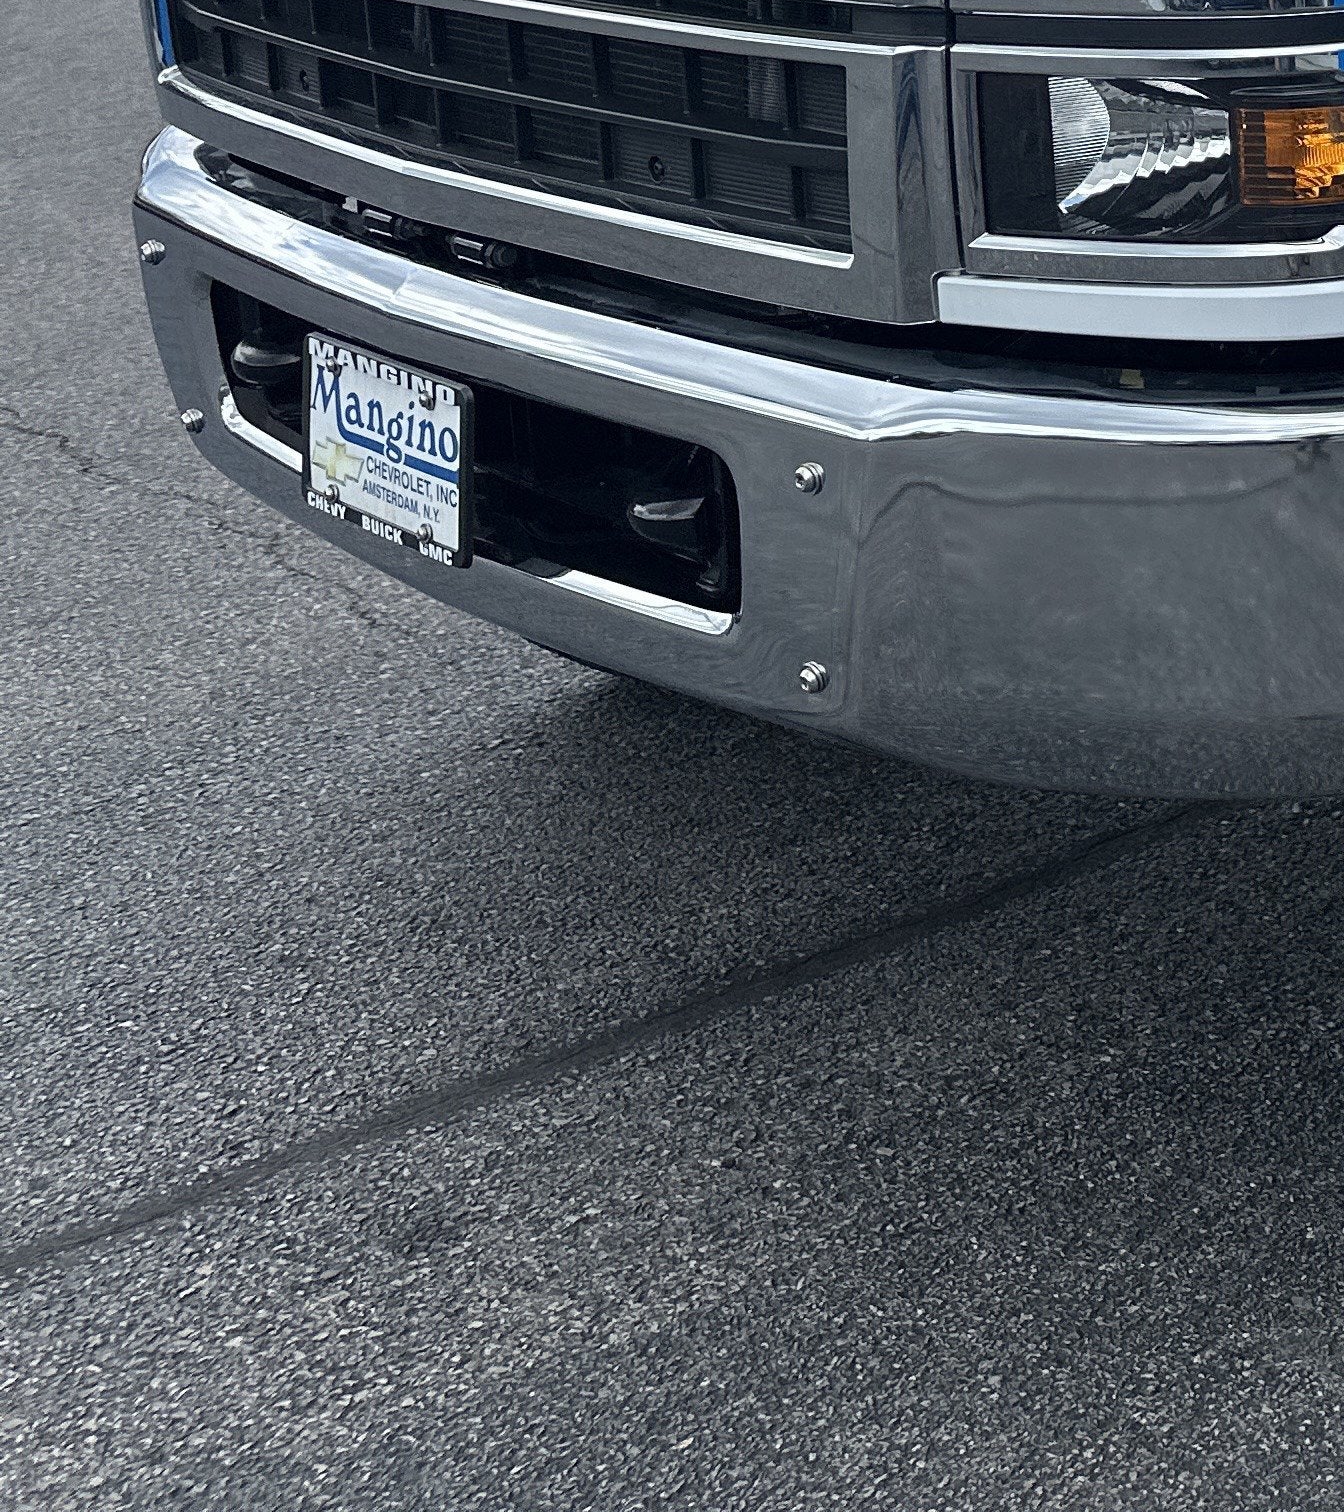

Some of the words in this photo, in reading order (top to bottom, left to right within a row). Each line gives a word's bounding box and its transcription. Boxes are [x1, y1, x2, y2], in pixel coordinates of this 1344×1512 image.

[308, 337, 455, 406] MANGINO
[310, 363, 459, 464] Mangino
[362, 479, 421, 515] AMSTERDAM,
[366, 455, 434, 501] CHEVROLET,
[307, 491, 347, 520] CHEVY
[361, 514, 403, 546] BUICK
